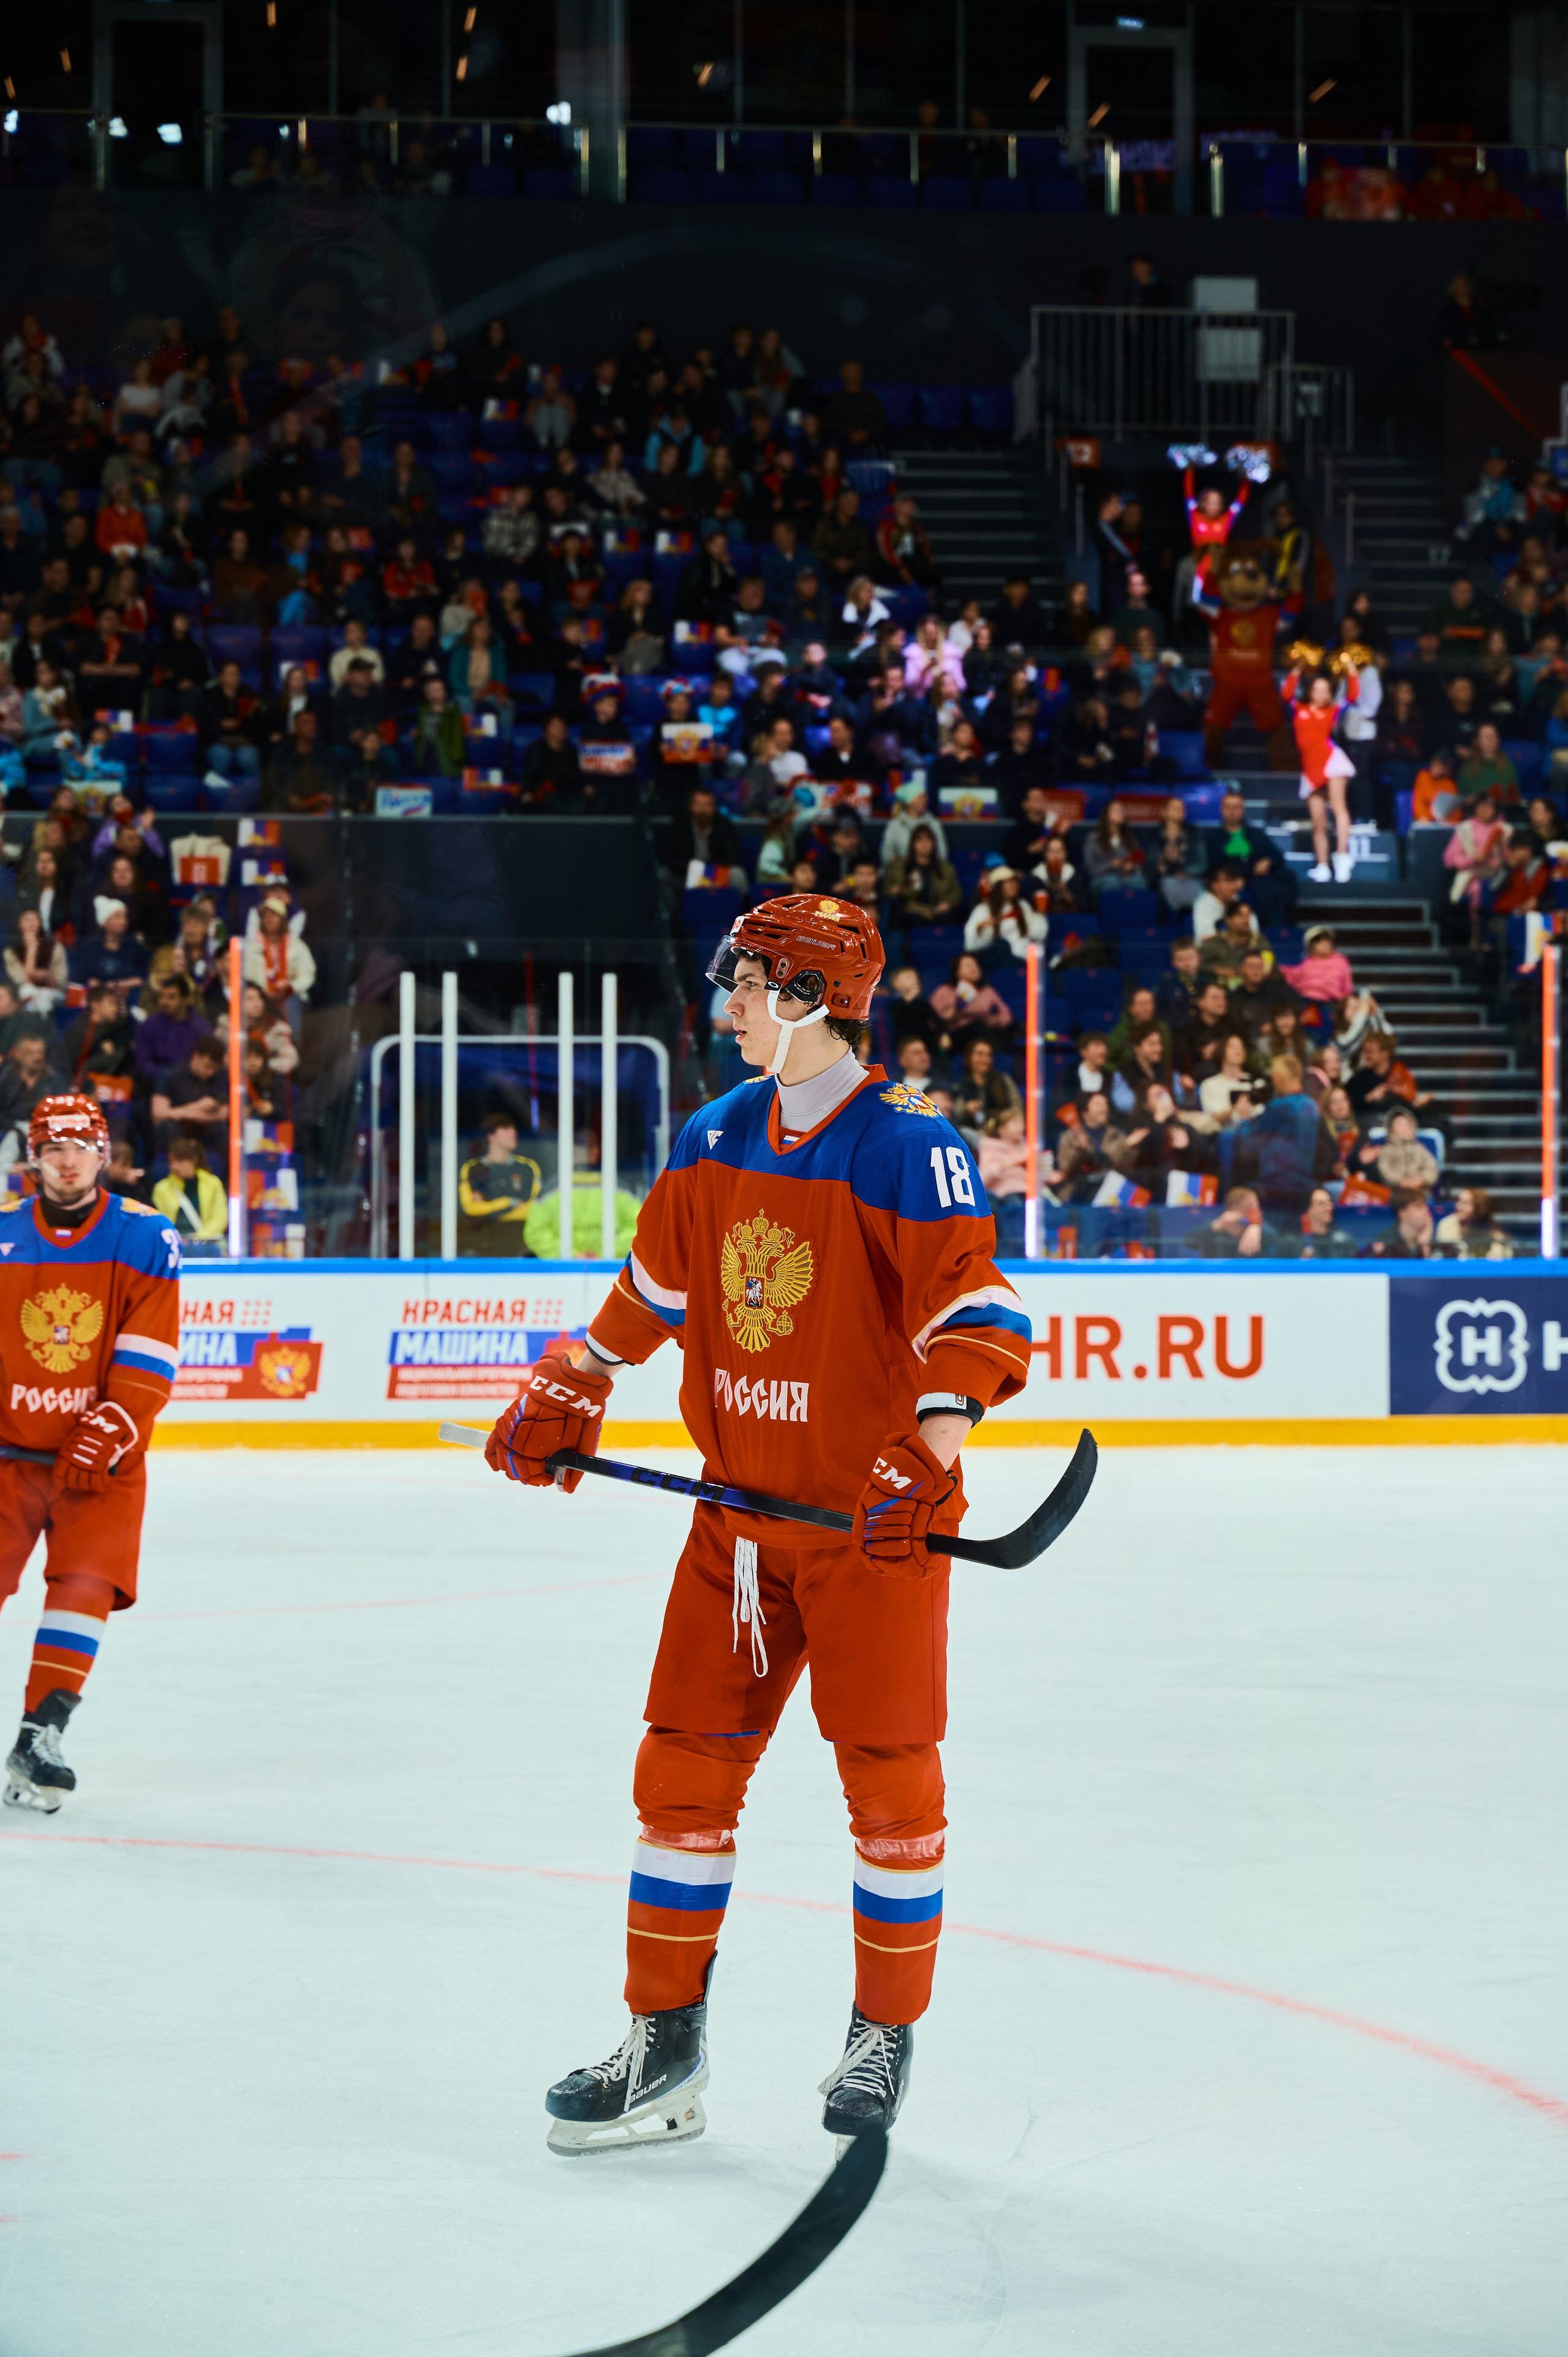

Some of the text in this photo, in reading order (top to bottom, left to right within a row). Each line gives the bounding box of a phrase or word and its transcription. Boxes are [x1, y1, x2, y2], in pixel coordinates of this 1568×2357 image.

[930, 1146, 976, 1208] 18
[161, 1228, 183, 1270] 3
[402, 1299, 527, 1324] КРАСНАЯ
[394, 1331, 529, 1365] МАШИНА
[529, 1375, 602, 1417] CCM
[714, 1368, 809, 1422] РОССИЯ
[631, 1467, 726, 1502] CCM
